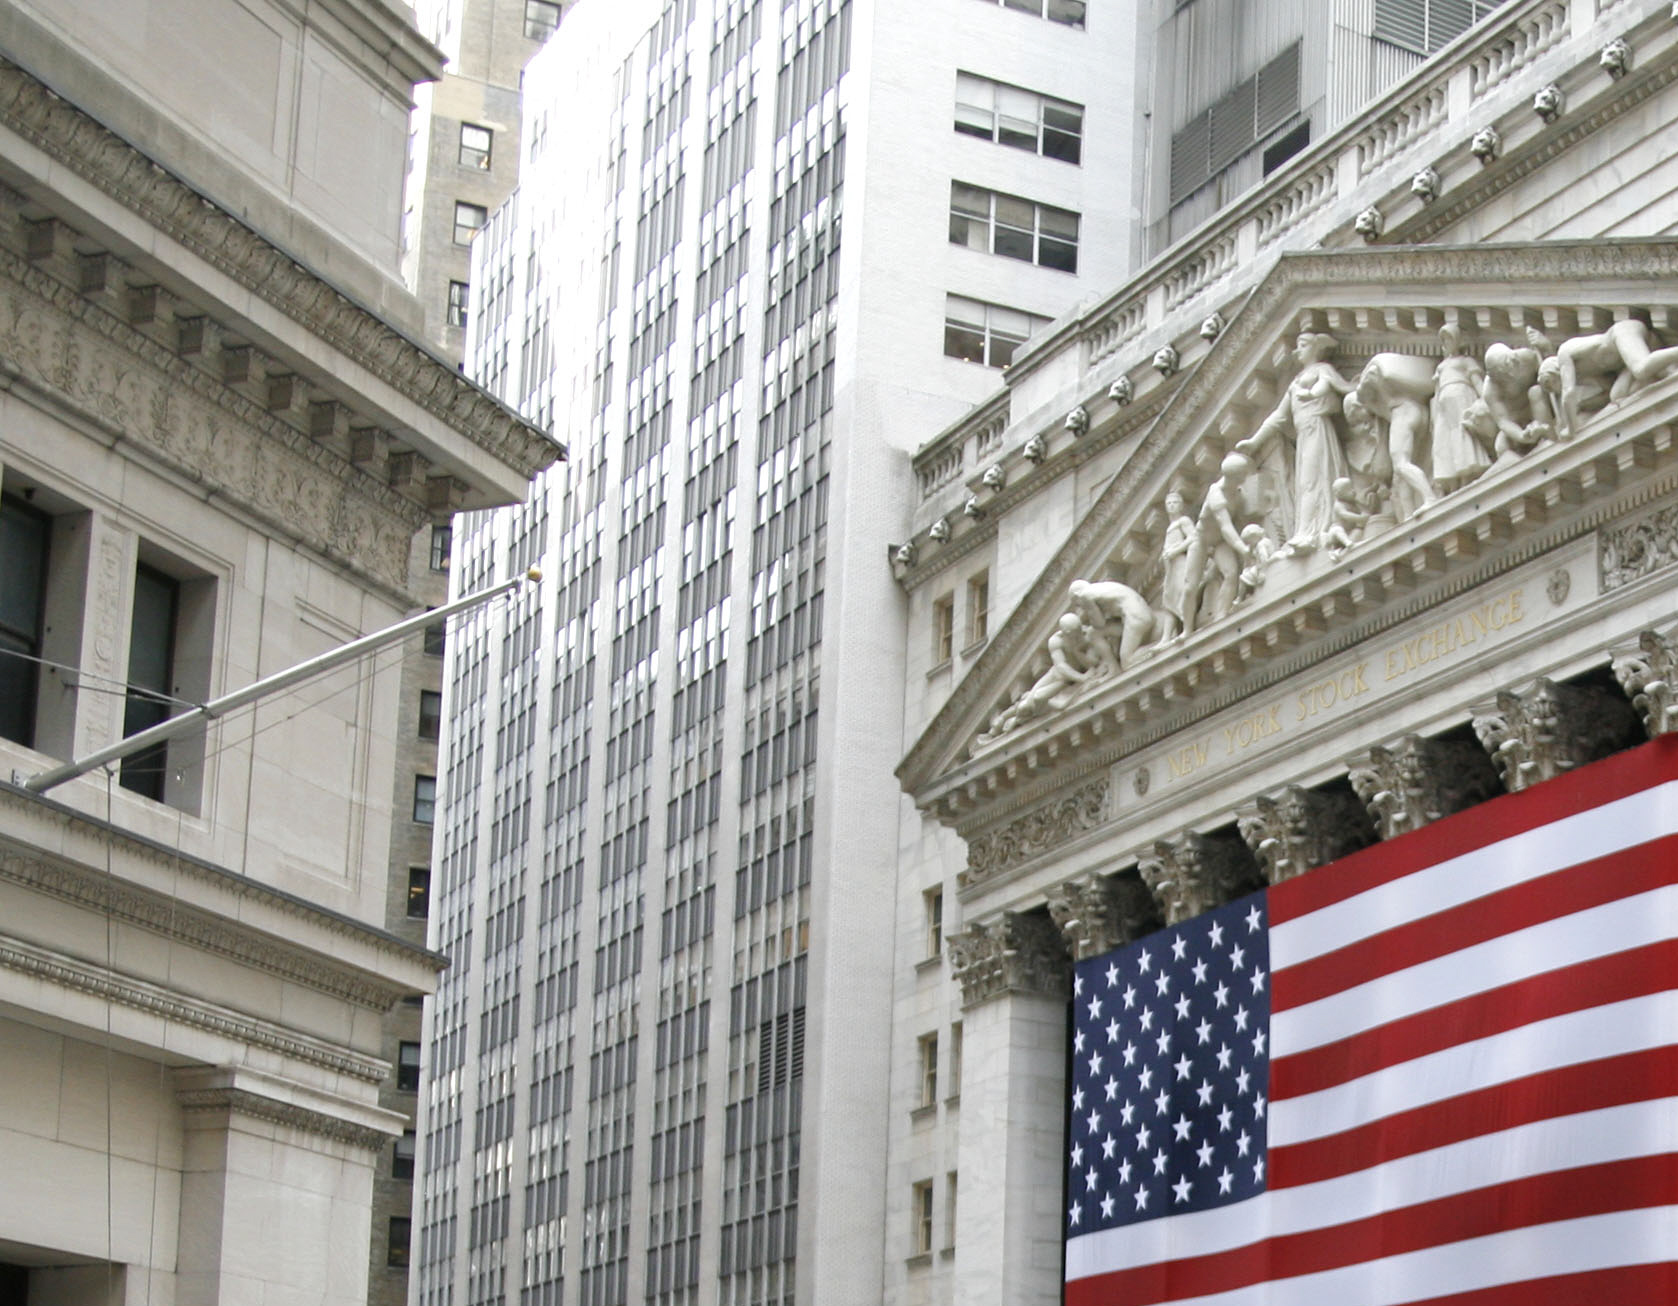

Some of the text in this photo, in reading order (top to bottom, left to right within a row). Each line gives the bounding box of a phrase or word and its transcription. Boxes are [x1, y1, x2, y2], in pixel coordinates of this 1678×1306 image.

[1167, 590, 1524, 783] NEW YORK STOCK EXCHANGE
